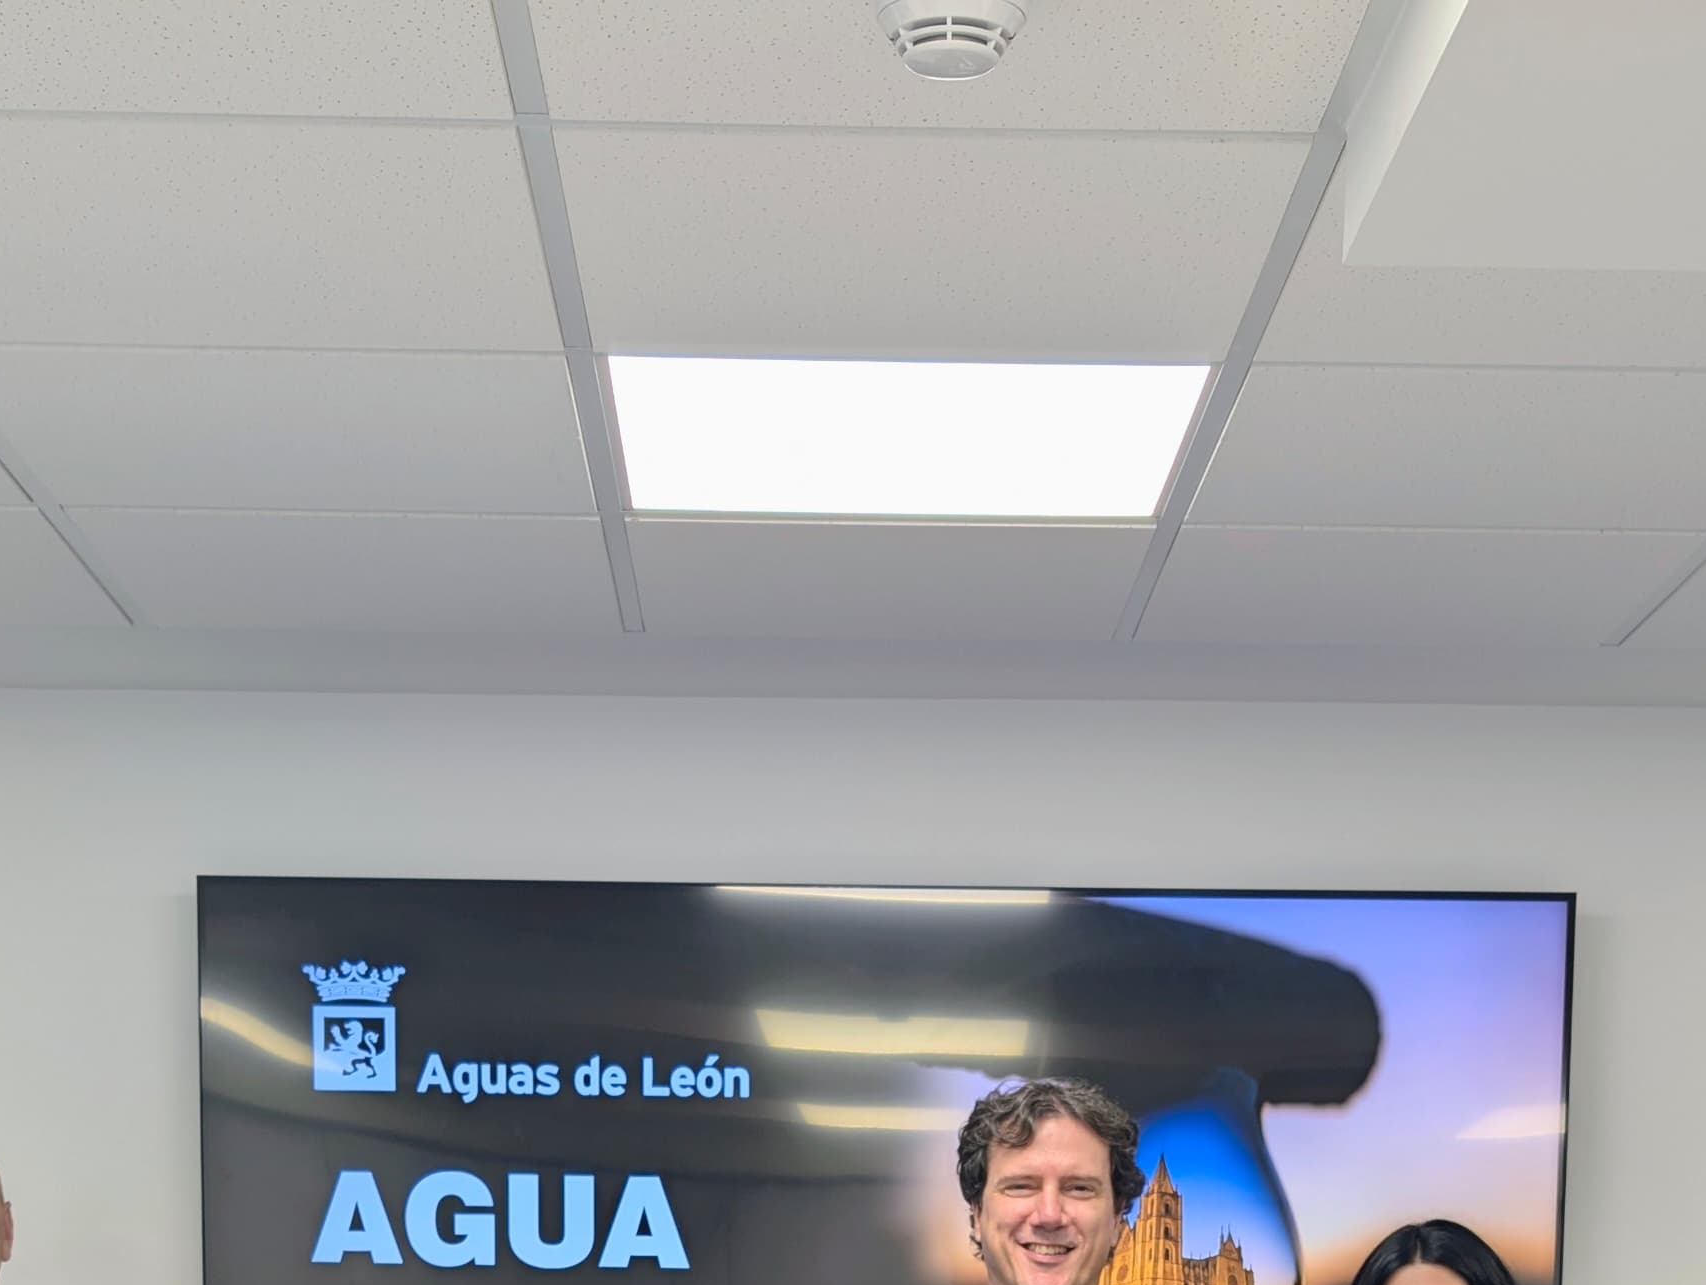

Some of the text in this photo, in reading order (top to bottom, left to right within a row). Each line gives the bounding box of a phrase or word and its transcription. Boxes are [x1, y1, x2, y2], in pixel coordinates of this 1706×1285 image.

[416, 1052, 751, 1104] Aguas de León
[310, 1169, 691, 1270] AGUA
